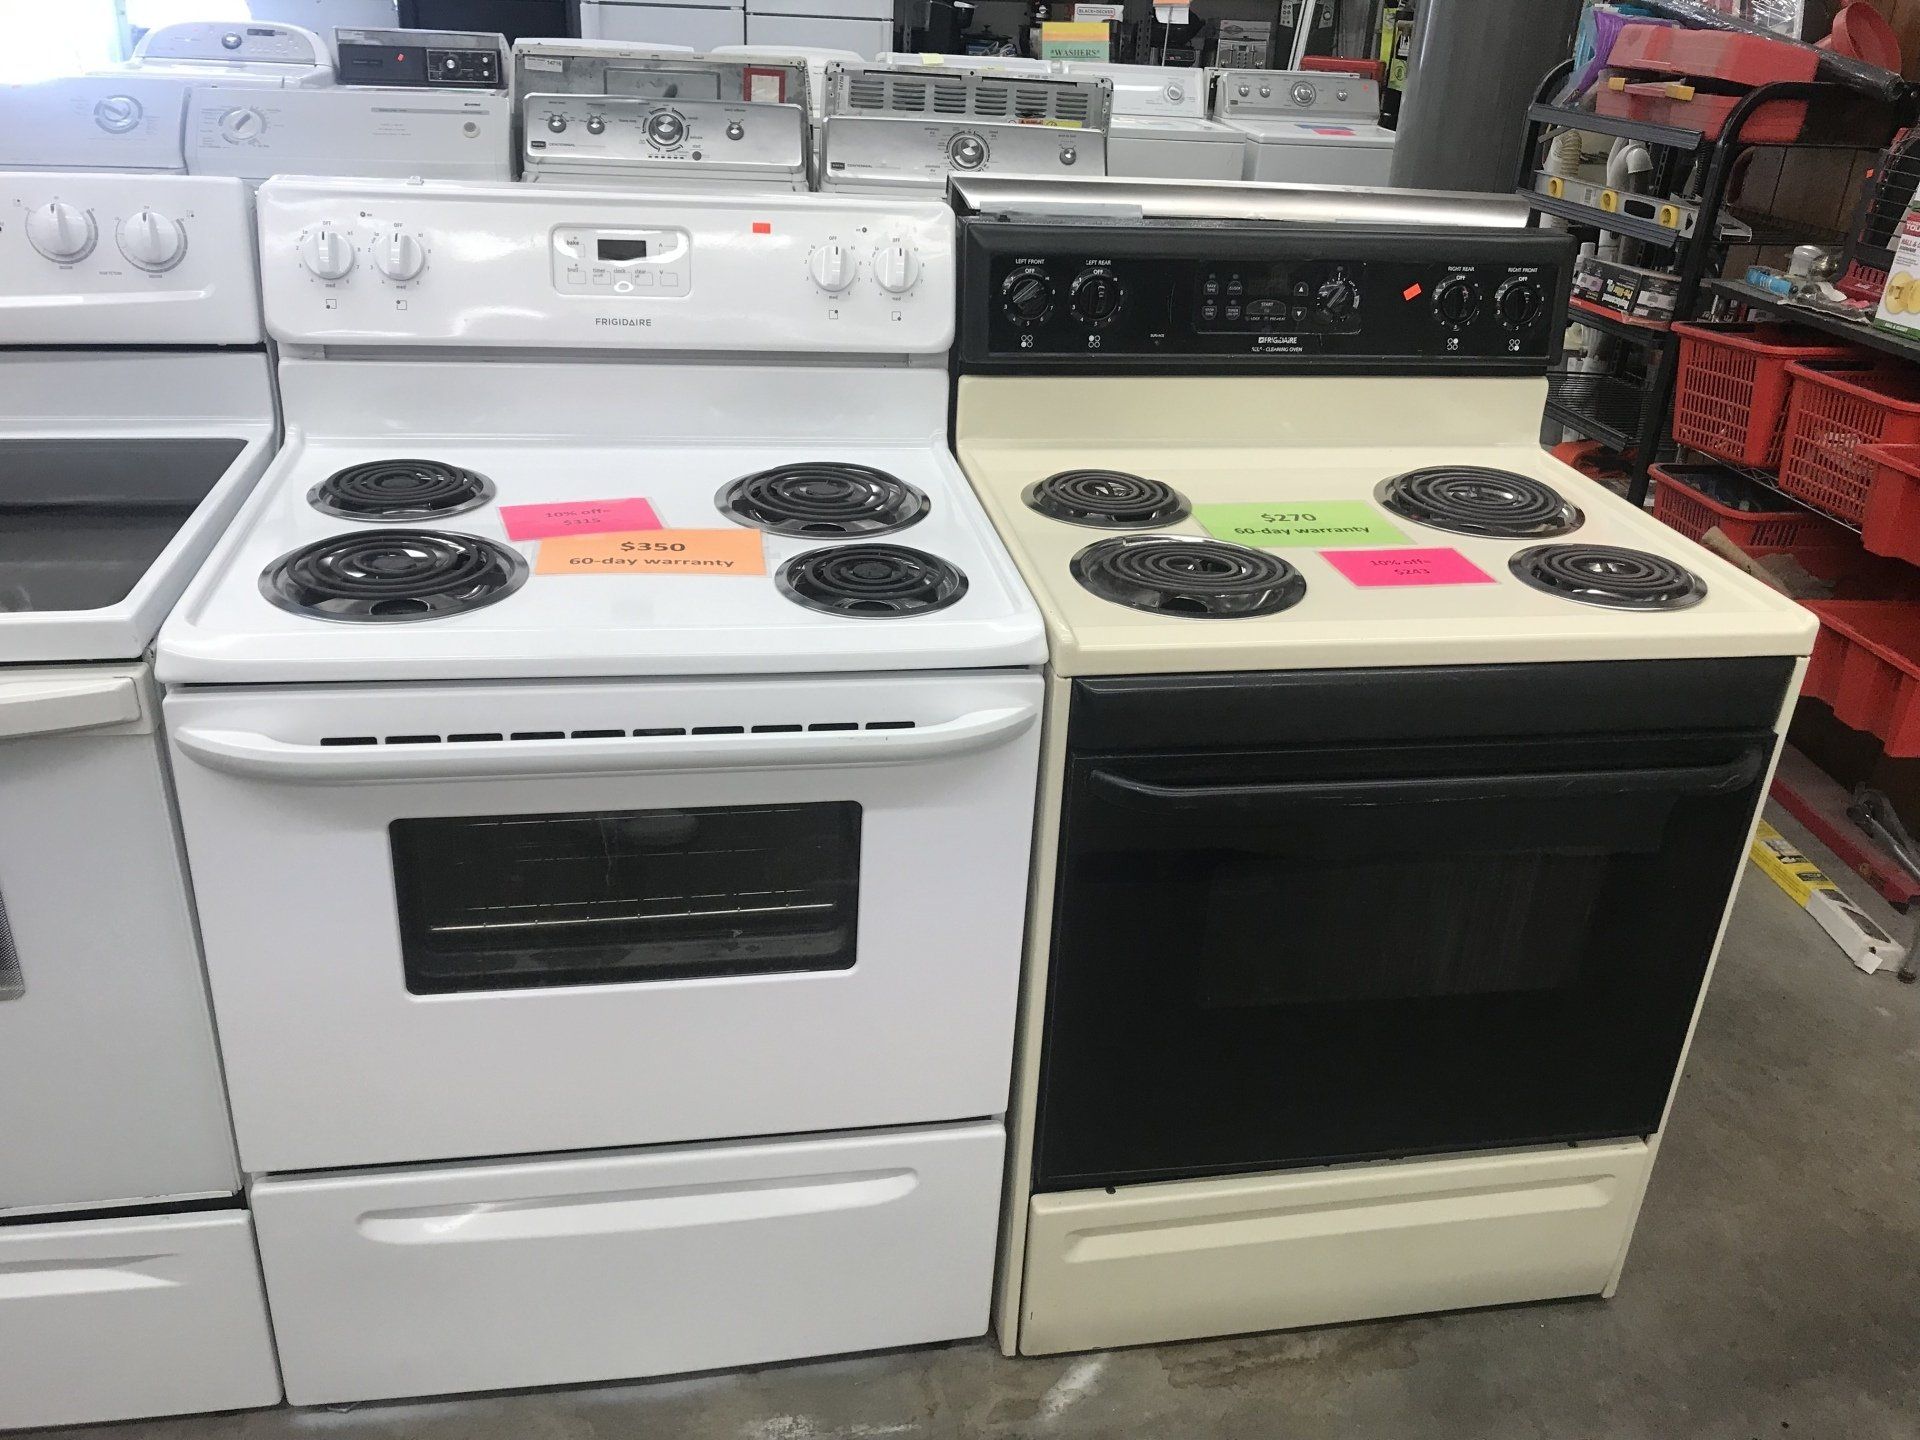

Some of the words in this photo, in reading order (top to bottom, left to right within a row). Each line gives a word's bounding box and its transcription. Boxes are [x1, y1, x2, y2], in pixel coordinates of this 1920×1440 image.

[595, 318, 652, 327] FRIGIDAIRE
[1261, 513, 1317, 523] $270
[1234, 527, 1291, 535] 60-day
[1294, 526, 1370, 534] warranty
[620, 541, 686, 552] $350
[569, 557, 638, 566] 60-day
[644, 558, 735, 568] warranty
